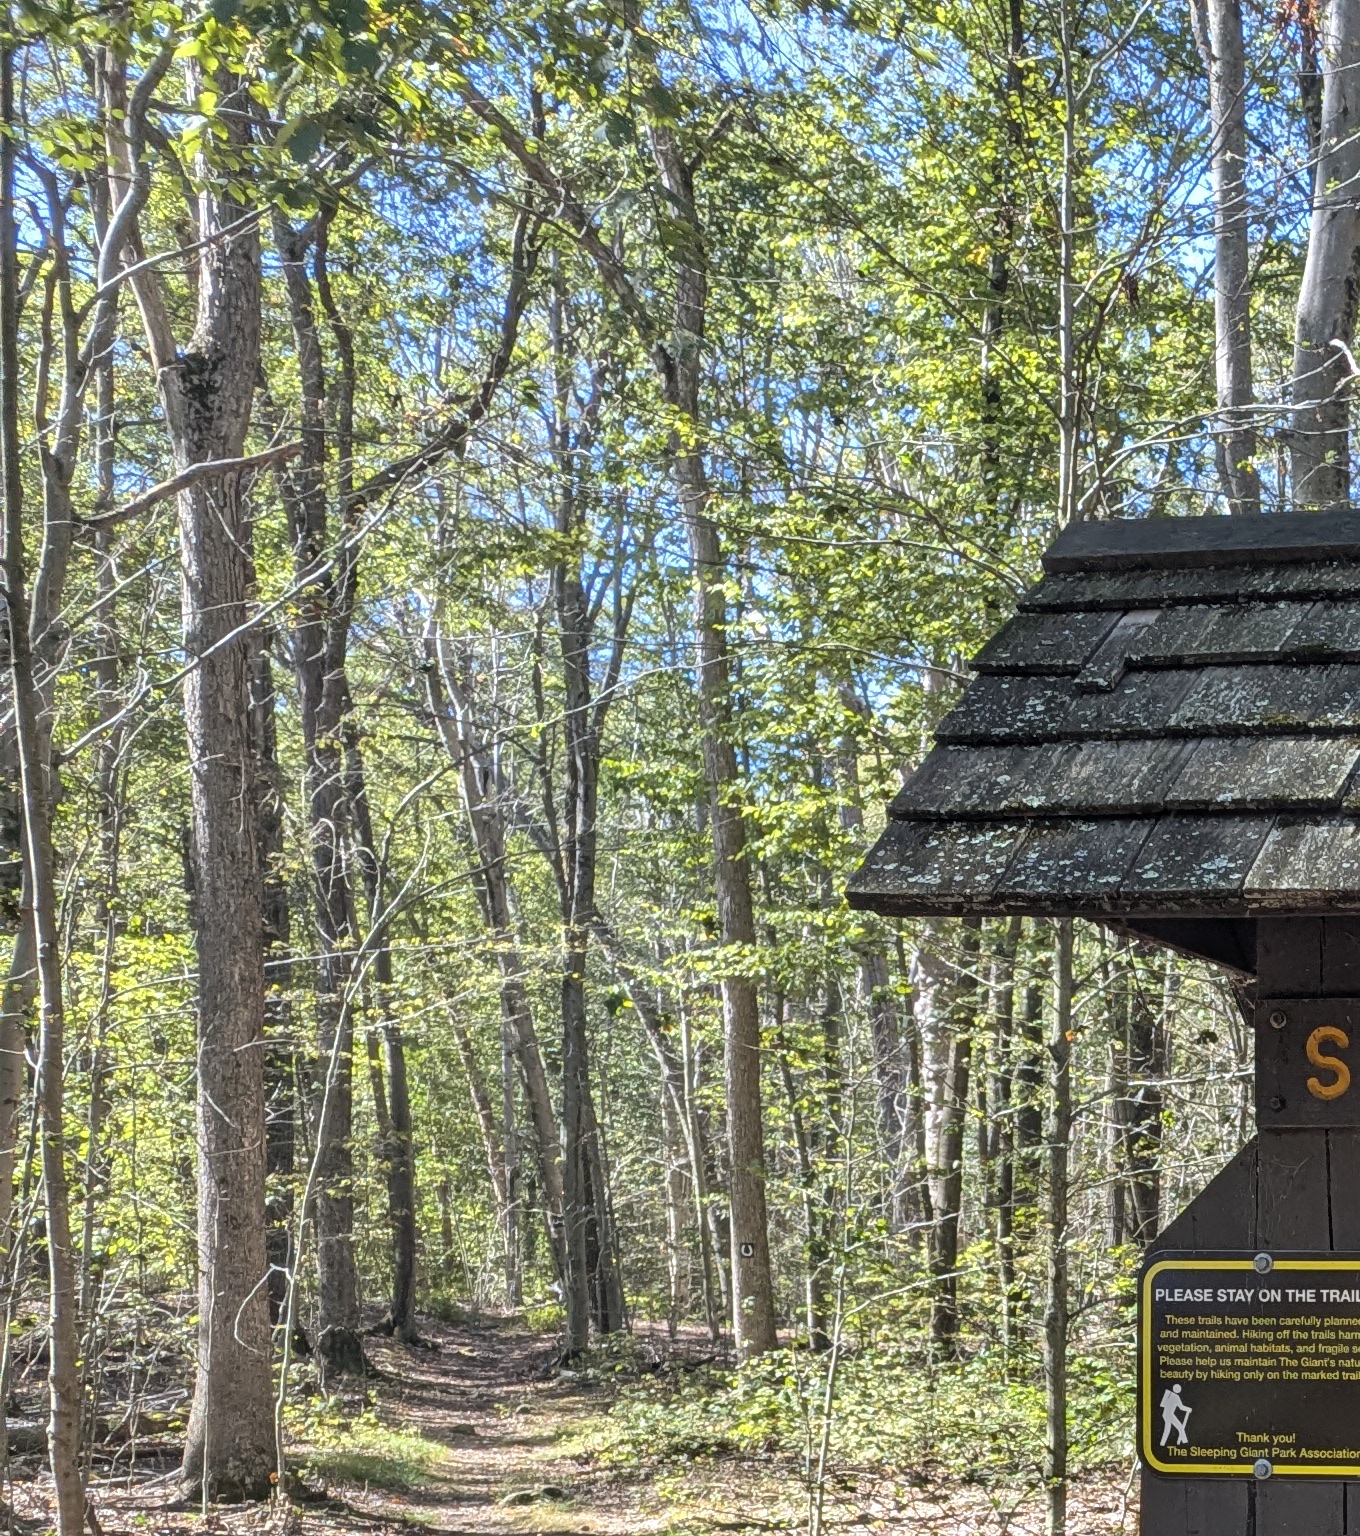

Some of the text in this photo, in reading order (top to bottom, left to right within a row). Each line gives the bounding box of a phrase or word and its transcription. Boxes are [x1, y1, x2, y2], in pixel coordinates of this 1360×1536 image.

[1156, 1289, 1213, 1303] PLEASE
[1217, 1289, 1253, 1303] STAY
[1259, 1289, 1282, 1303] ON
[1286, 1289, 1316, 1303] THE
[1165, 1315, 1195, 1326] These
[1198, 1315, 1223, 1326] trails
[1225, 1315, 1249, 1326] have
[1252, 1315, 1277, 1326] been
[1279, 1315, 1321, 1327] carefully
[1160, 1329, 1179, 1339] and
[1182, 1329, 1239, 1339] maintained.
[1242, 1330, 1274, 1341] Hiking
[1276, 1329, 1290, 1339] off
[1293, 1329, 1308, 1339] the
[1311, 1330, 1335, 1340] trails
[1157, 1344, 1212, 1354] vegetation,
[1215, 1343, 1247, 1353] animal
[1251, 1343, 1293, 1354] habitats,
[1297, 1343, 1315, 1353] and
[1318, 1344, 1350, 1355] fragile
[1160, 1357, 1193, 1367] Please
[1195, 1357, 1217, 1368] help
[1234, 1357, 1277, 1367] maintain
[1280, 1357, 1298, 1367] The
[1301, 1358, 1335, 1367] Giant's
[1160, 1370, 1194, 1380] beauty
[1196, 1370, 1208, 1381] by
[1211, 1370, 1241, 1381] hiking
[1243, 1370, 1264, 1381] only
[1267, 1372, 1280, 1380] on
[1283, 1370, 1298, 1380] the
[1301, 1370, 1339, 1380] marked
[1236, 1432, 1296, 1444] Thank you!
[1167, 1447, 1187, 1456] The
[1190, 1447, 1236, 1459] Sleeping
[1240, 1447, 1268, 1458] Giant
[1271, 1447, 1296, 1458] Park
